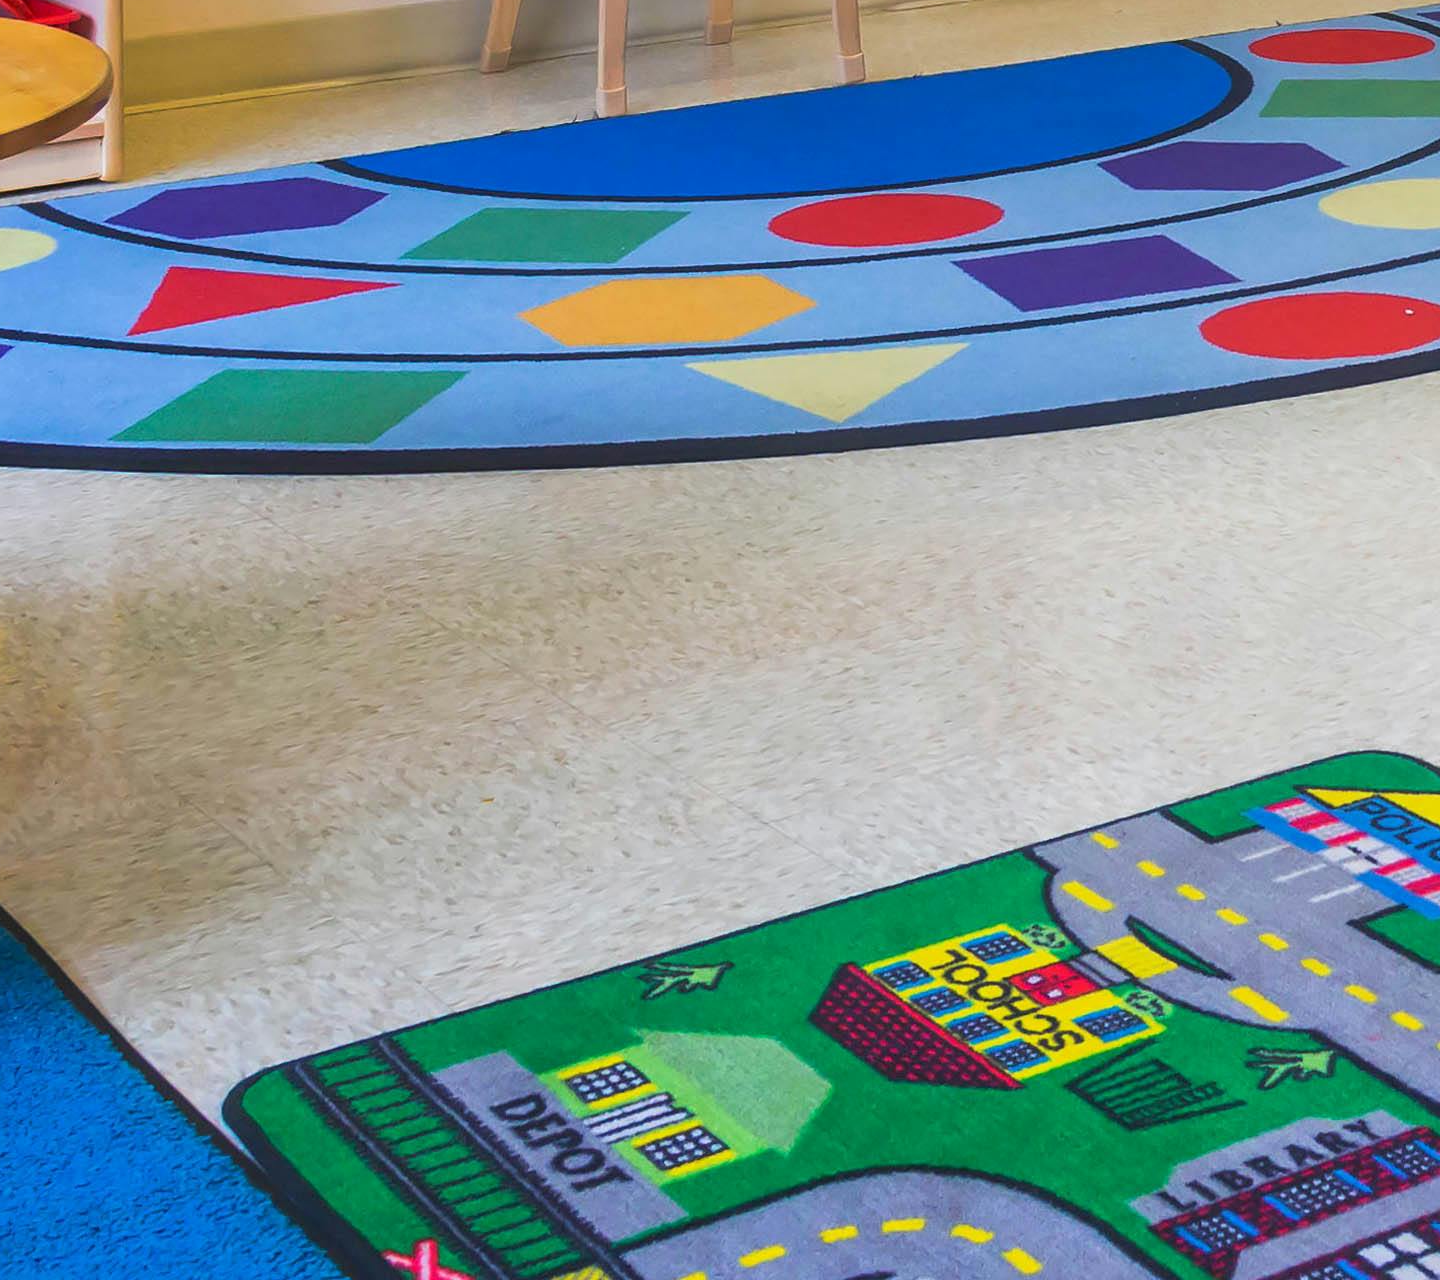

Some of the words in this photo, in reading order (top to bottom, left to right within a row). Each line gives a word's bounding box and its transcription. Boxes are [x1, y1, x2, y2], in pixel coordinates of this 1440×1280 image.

[929, 948, 1086, 1052] SCHOOL
[487, 1092, 634, 1194] DEPOT
[1155, 1117, 1376, 1216] LIBRARY
